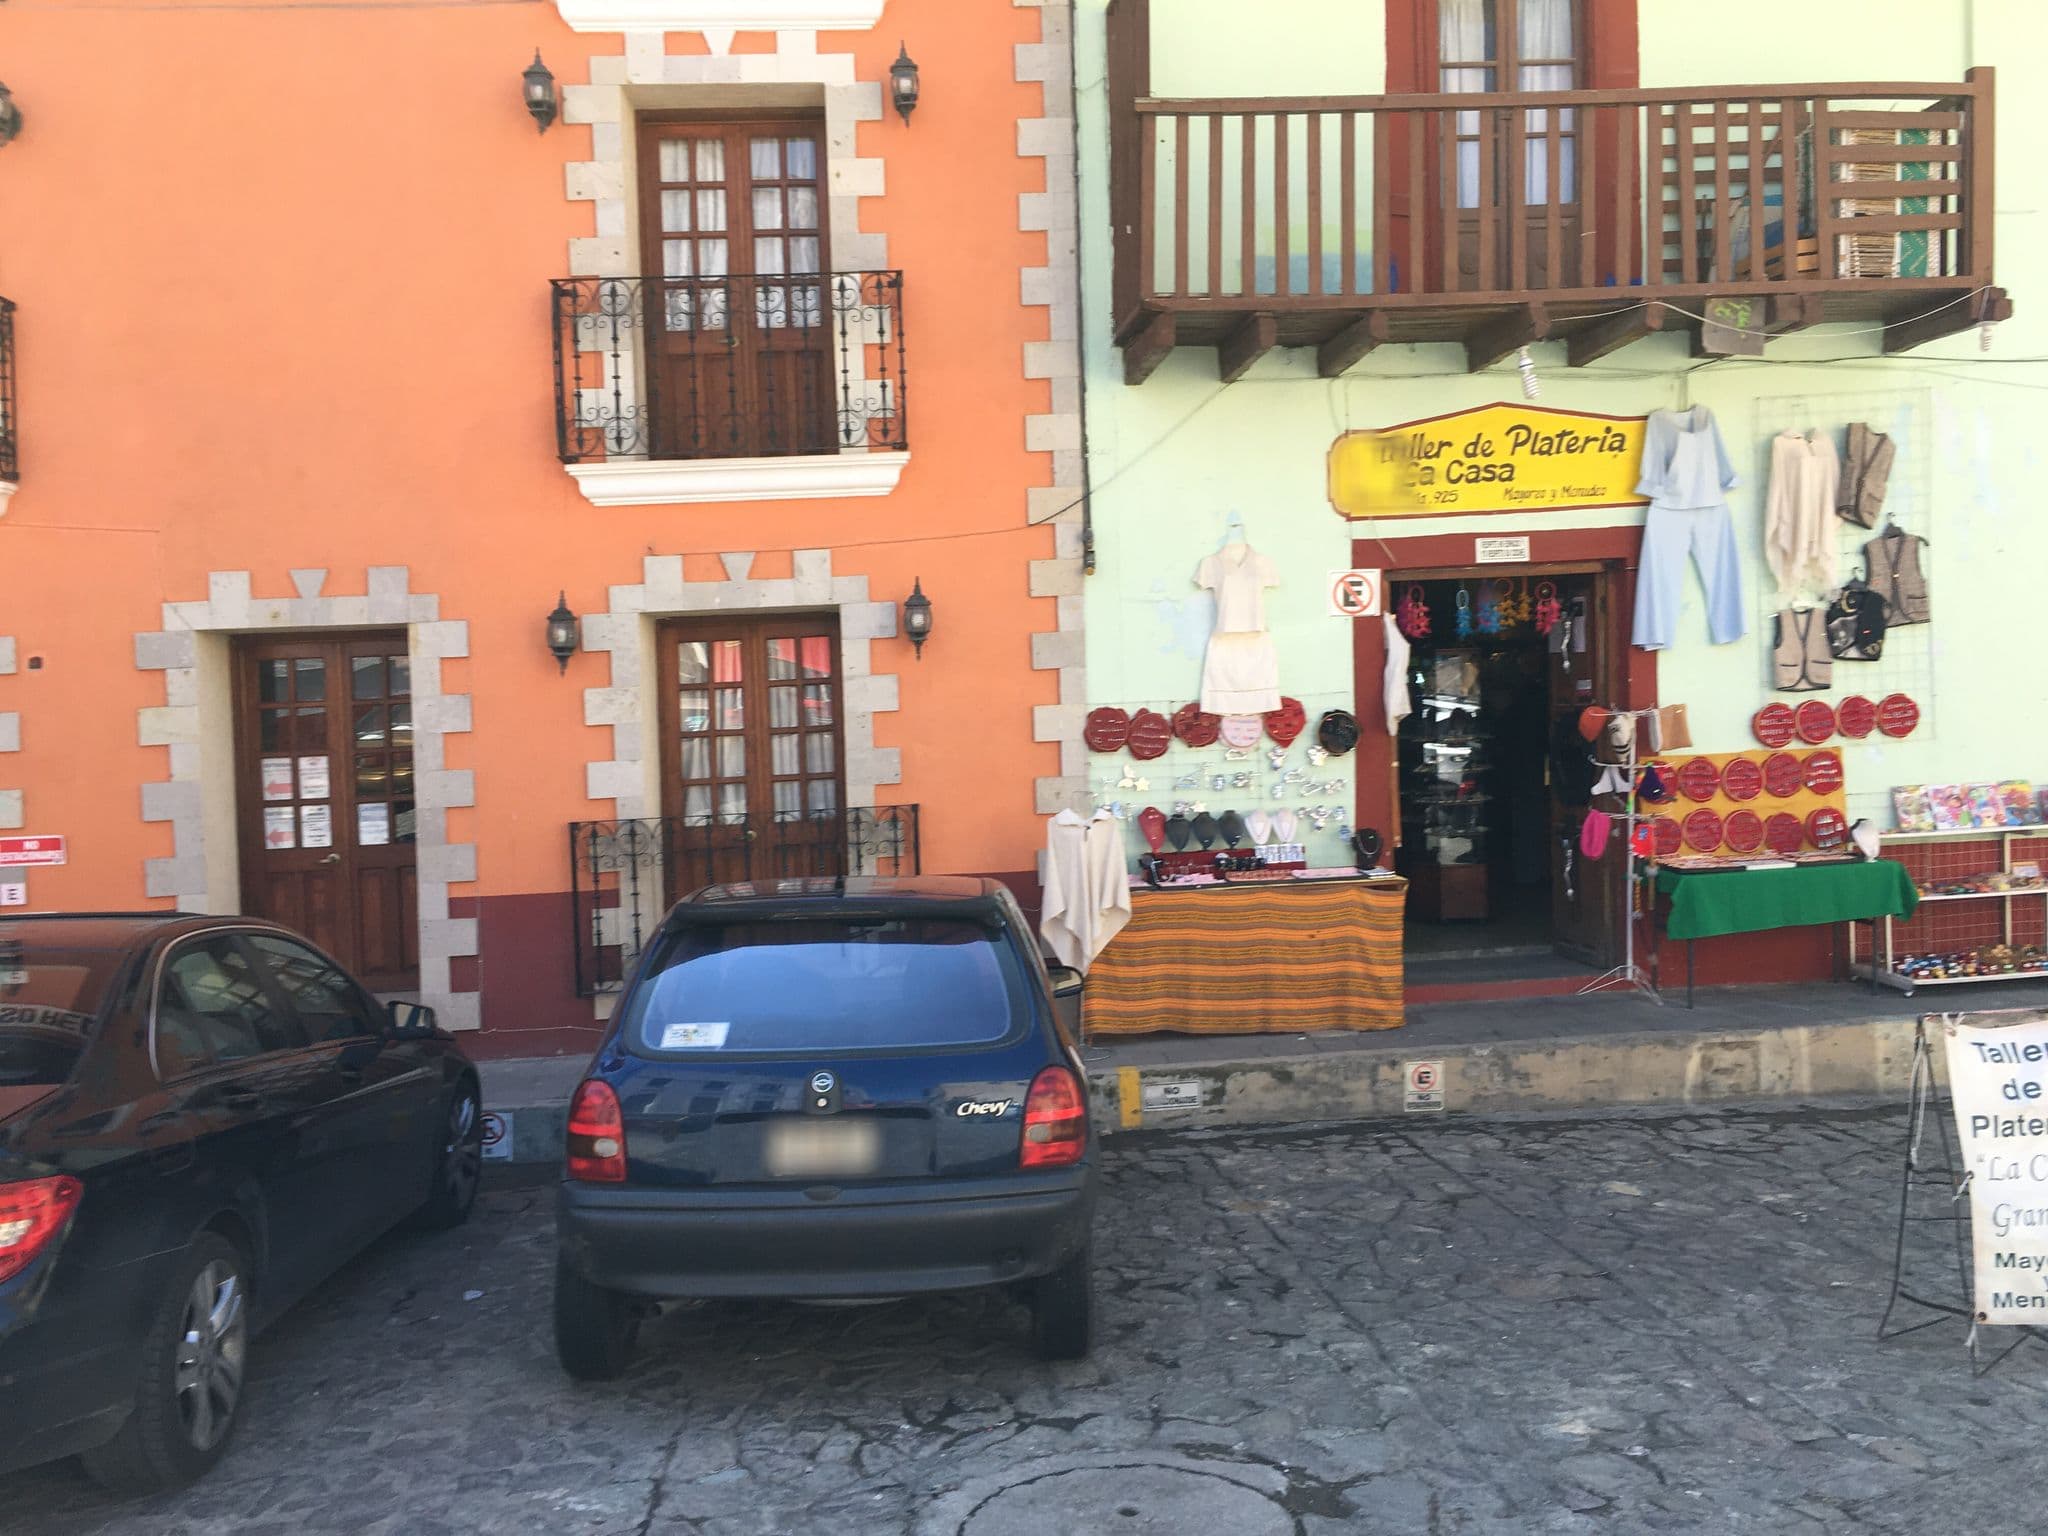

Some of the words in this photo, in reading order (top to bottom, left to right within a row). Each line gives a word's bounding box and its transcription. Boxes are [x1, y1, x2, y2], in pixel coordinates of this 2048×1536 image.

[1463, 432, 1495, 458] de
[1505, 424, 1627, 456] Plateria
[1446, 460, 1514, 484] Casa
[1970, 1041, 2048, 1064] Talle
[2002, 1077, 2043, 1101] de
[956, 1099, 1012, 1117] Chevy
[1971, 1114, 2048, 1138] Plate
